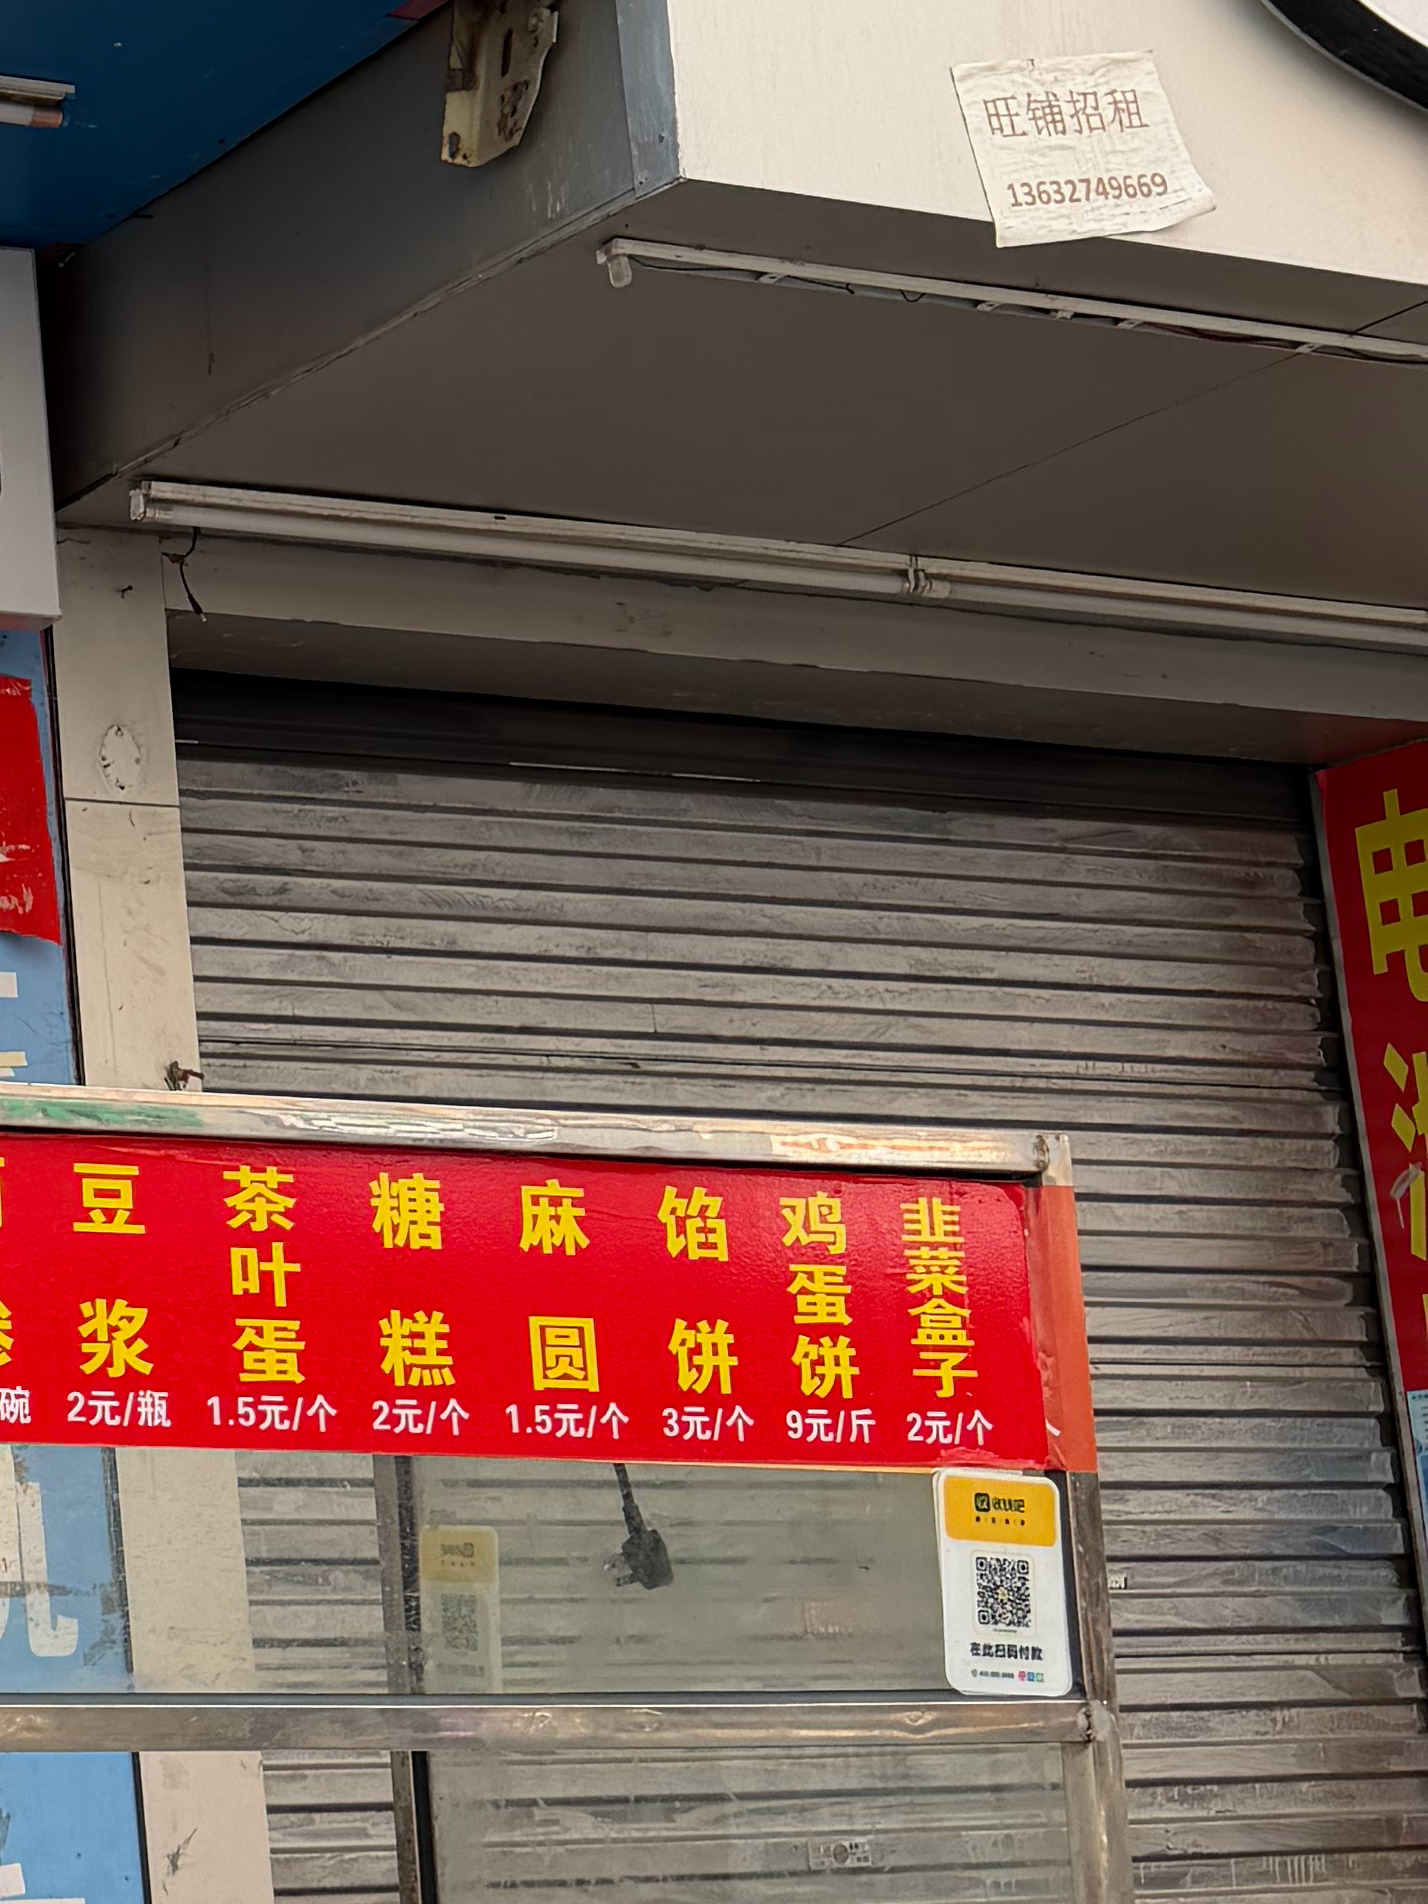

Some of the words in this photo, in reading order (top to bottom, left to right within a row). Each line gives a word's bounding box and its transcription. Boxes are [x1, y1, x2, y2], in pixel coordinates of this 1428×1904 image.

[982, 89, 1150, 137] 旺铺招租
[1006, 173, 1168, 207] 13632749669
[72, 1162, 155, 1378] 豆浆
[222, 1165, 307, 1384] 茶叶蛋
[370, 1171, 456, 1388] 糖糕
[519, 1179, 599, 1393] 麻圆
[658, 1185, 739, 1396] 馅饼
[779, 1191, 861, 1399] 鸡蛋饼
[899, 1195, 979, 1399] 韭菜盒子
[66, 1390, 172, 1429] 2元/瓶
[208, 1393, 337, 1434] 1.5元/个
[371, 1398, 470, 1436] 2元/个
[505, 1401, 629, 1440] 1.5元/个
[662, 1404, 754, 1444] 3元/个
[785, 1407, 876, 1445] 9元/斤
[906, 1409, 994, 1447] 2元/个
